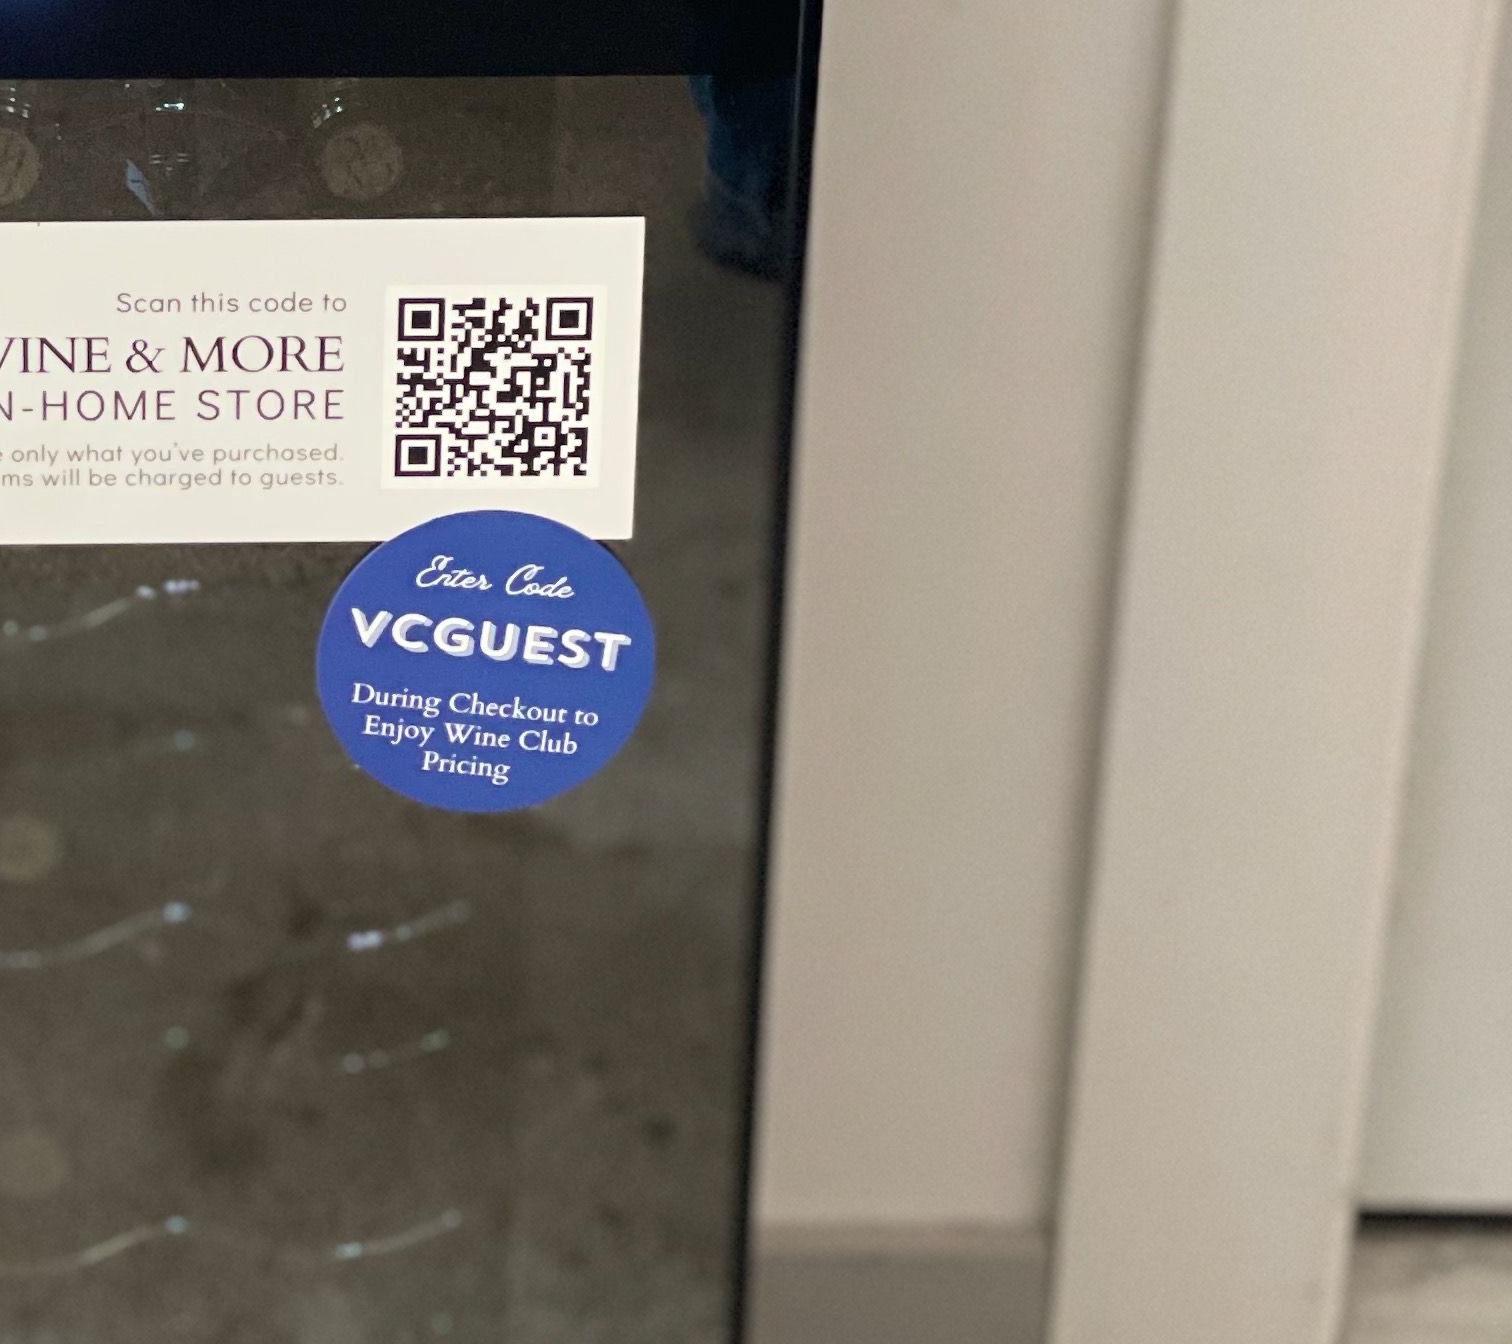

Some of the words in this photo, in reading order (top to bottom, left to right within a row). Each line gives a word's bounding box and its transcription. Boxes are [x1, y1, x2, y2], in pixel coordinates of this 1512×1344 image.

[116, 292, 181, 313] Scan
[191, 291, 240, 313] this
[248, 291, 314, 313] code
[322, 293, 348, 313] to
[124, 338, 166, 374] &
[179, 334, 345, 374] MORE
[196, 389, 345, 421] STORE
[10, 443, 59, 467] only
[66, 443, 123, 463] what
[130, 441, 206, 467] you've
[213, 442, 345, 466] purchased.
[41, 468, 81, 487] will
[88, 468, 117, 487] be
[125, 467, 222, 491] charged
[231, 469, 252, 487] to
[259, 468, 345, 491] guests.
[415, 554, 493, 591] Enter
[505, 563, 575, 599] Code
[351, 607, 632, 672] VCGUEST
[351, 682, 442, 718] During
[449, 691, 568, 724] Checkout
[574, 710, 599, 727] to
[361, 713, 435, 747] Enjoy
[444, 721, 511, 748] Wine
[518, 729, 579, 755] Club
[420, 750, 511, 786] Pricing
